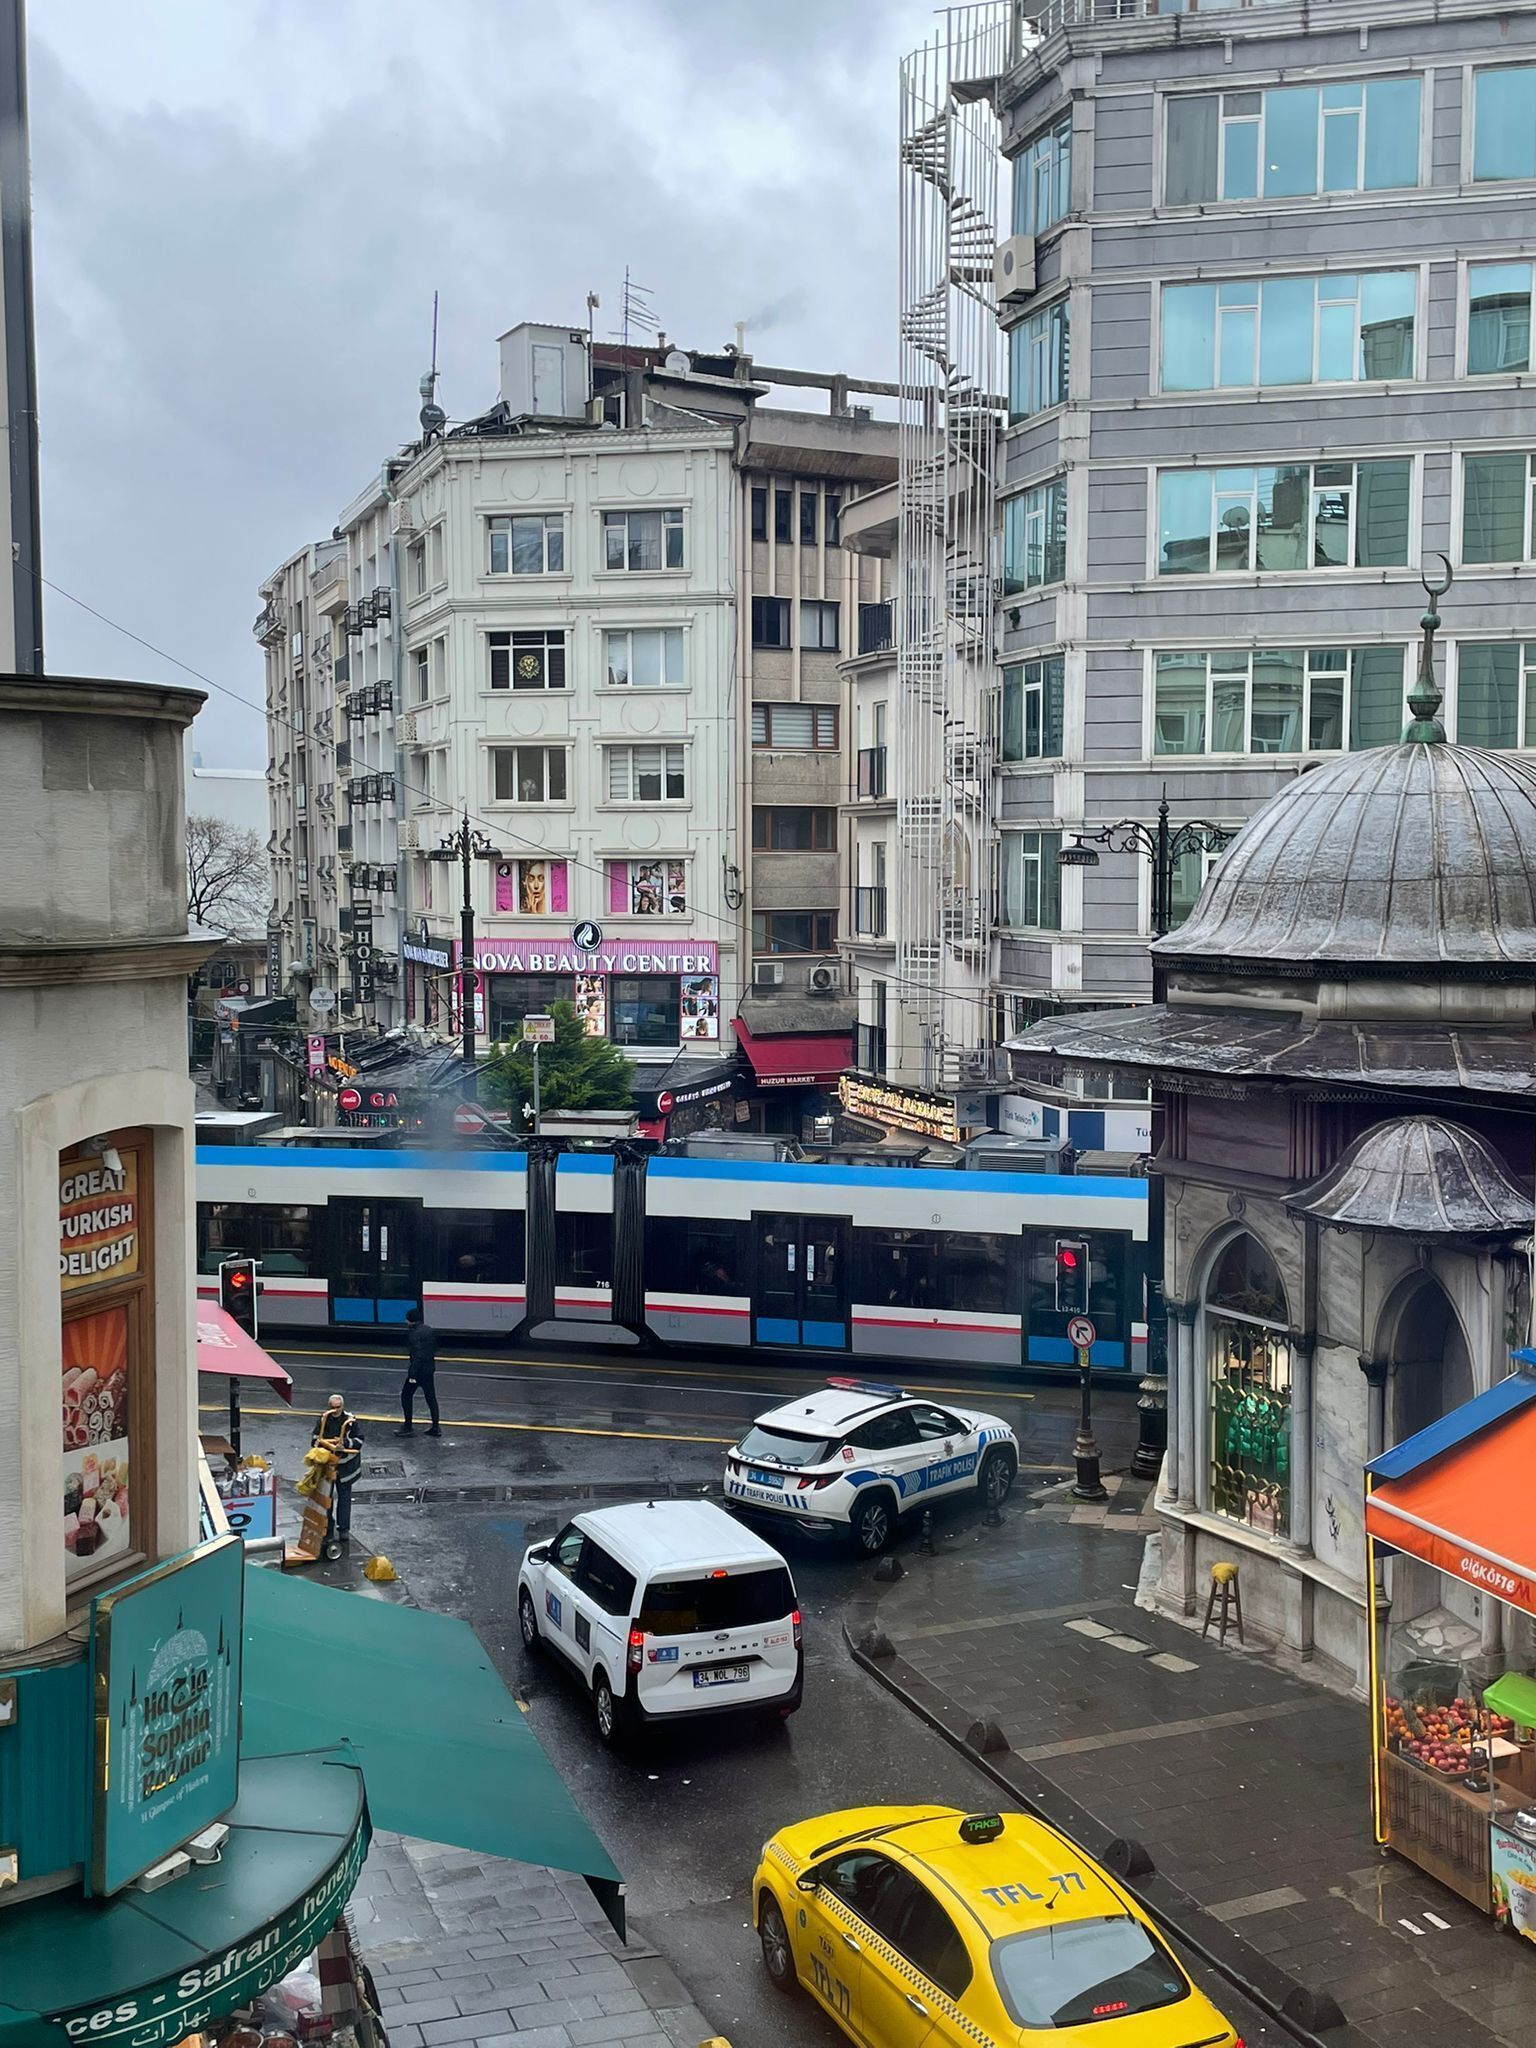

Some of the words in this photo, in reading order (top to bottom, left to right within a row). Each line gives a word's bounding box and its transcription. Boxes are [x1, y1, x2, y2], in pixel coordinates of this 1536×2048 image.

[271, 964, 279, 996] HOTEL
[356, 930, 371, 1003] HOTEL
[529, 953, 617, 973] BEAUTY
[622, 953, 712, 974] CENTER
[760, 1077, 786, 1085] HUZUR
[786, 1075, 815, 1084] MARKET
[60, 1169, 127, 1204] GREAT
[59, 1203, 133, 1240] TURKISH
[59, 1234, 134, 1276] DELIGHT
[595, 1280, 611, 1289] 716
[684, 1642, 759, 1657] TOURNEO
[699, 1671, 709, 1683] 34
[732, 1666, 748, 1679] 796
[142, 1708, 210, 1768] Sophia
[981, 1882, 1044, 1907] TFL
[1048, 1871, 1087, 1895] 77
[176, 1926, 281, 1999] Safran
[303, 1849, 352, 1921] honey
[835, 1977, 850, 2019] 77
